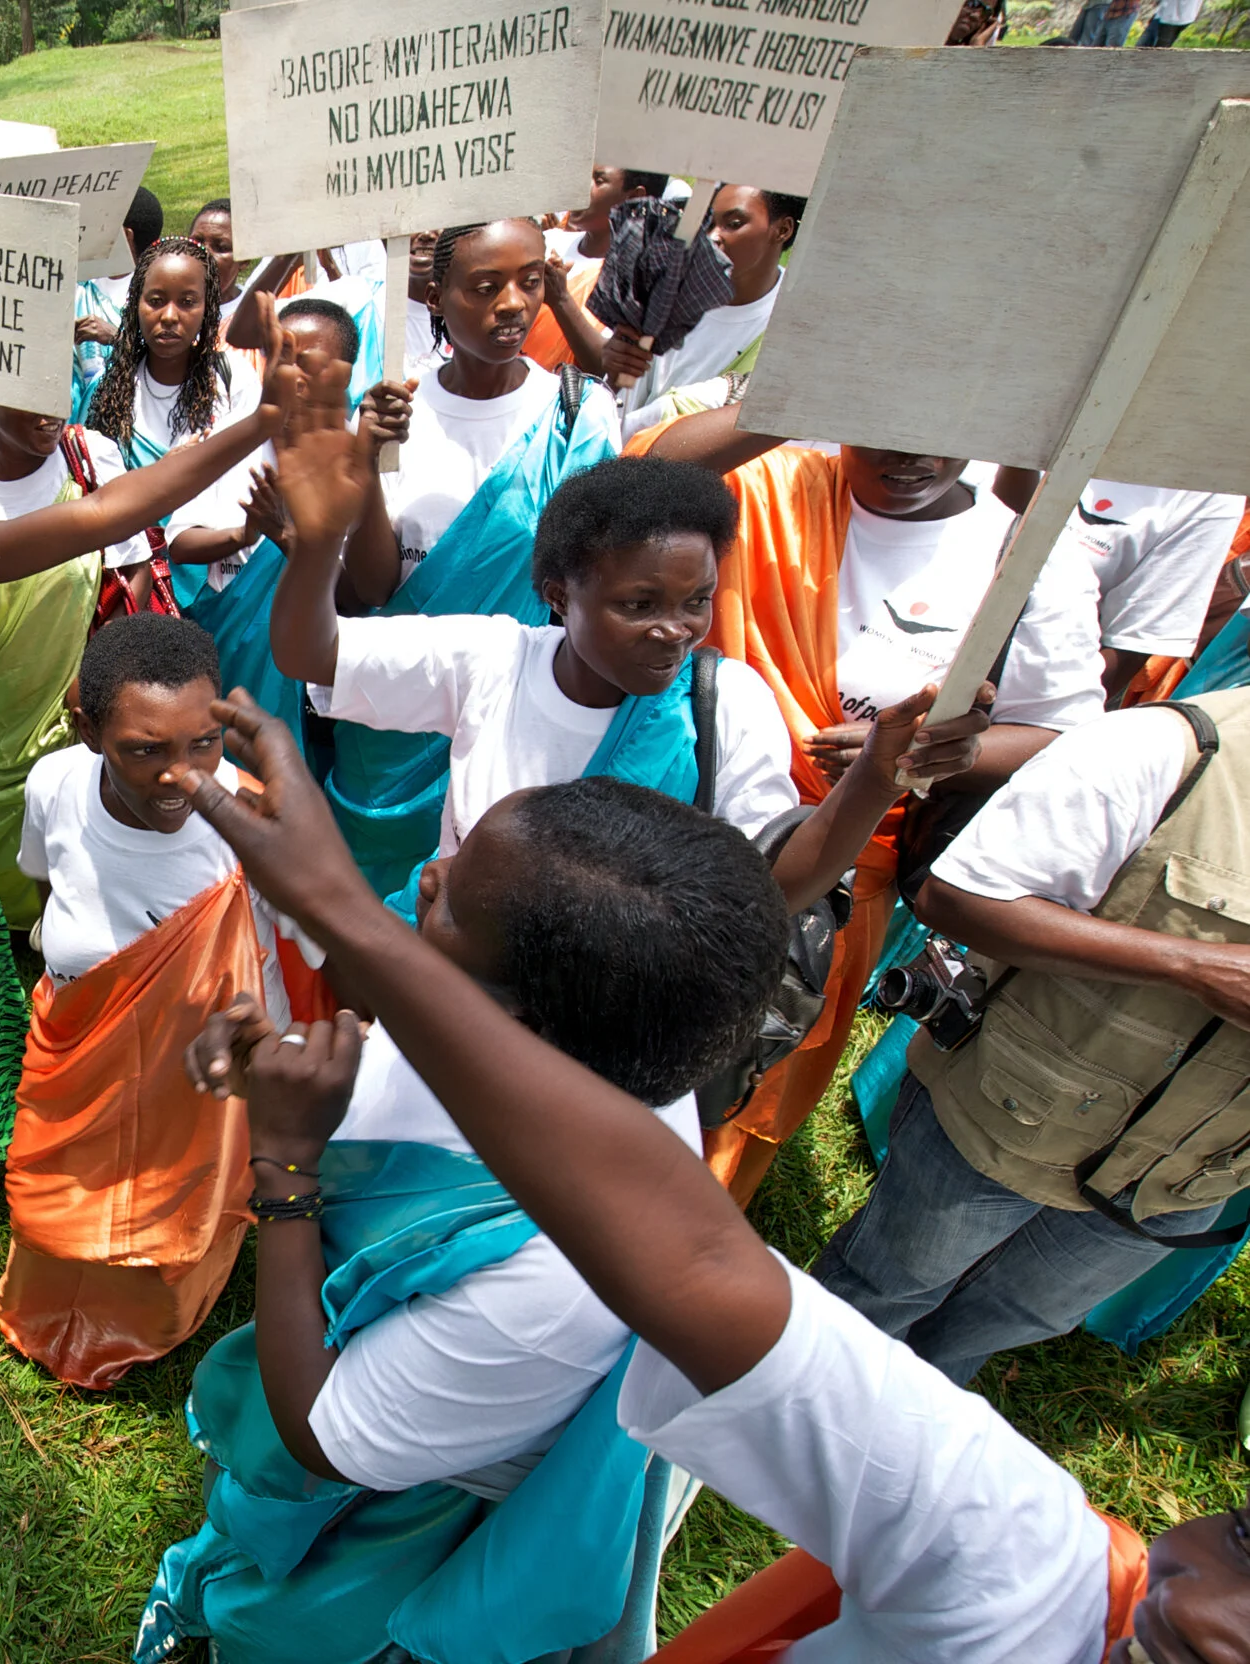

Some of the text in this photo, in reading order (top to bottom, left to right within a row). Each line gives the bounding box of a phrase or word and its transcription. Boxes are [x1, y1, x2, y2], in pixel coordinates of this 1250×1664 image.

[603, 10, 757, 66] TWAMAGANNYE
[272, 42, 374, 99] BAGORE
[638, 67, 827, 131] KU MUGORE KU ISI
[328, 76, 512, 146] NO KUDAHEZWA
[51, 169, 123, 197] PEACE
[326, 131, 517, 198] MU MYUGA YOSE
